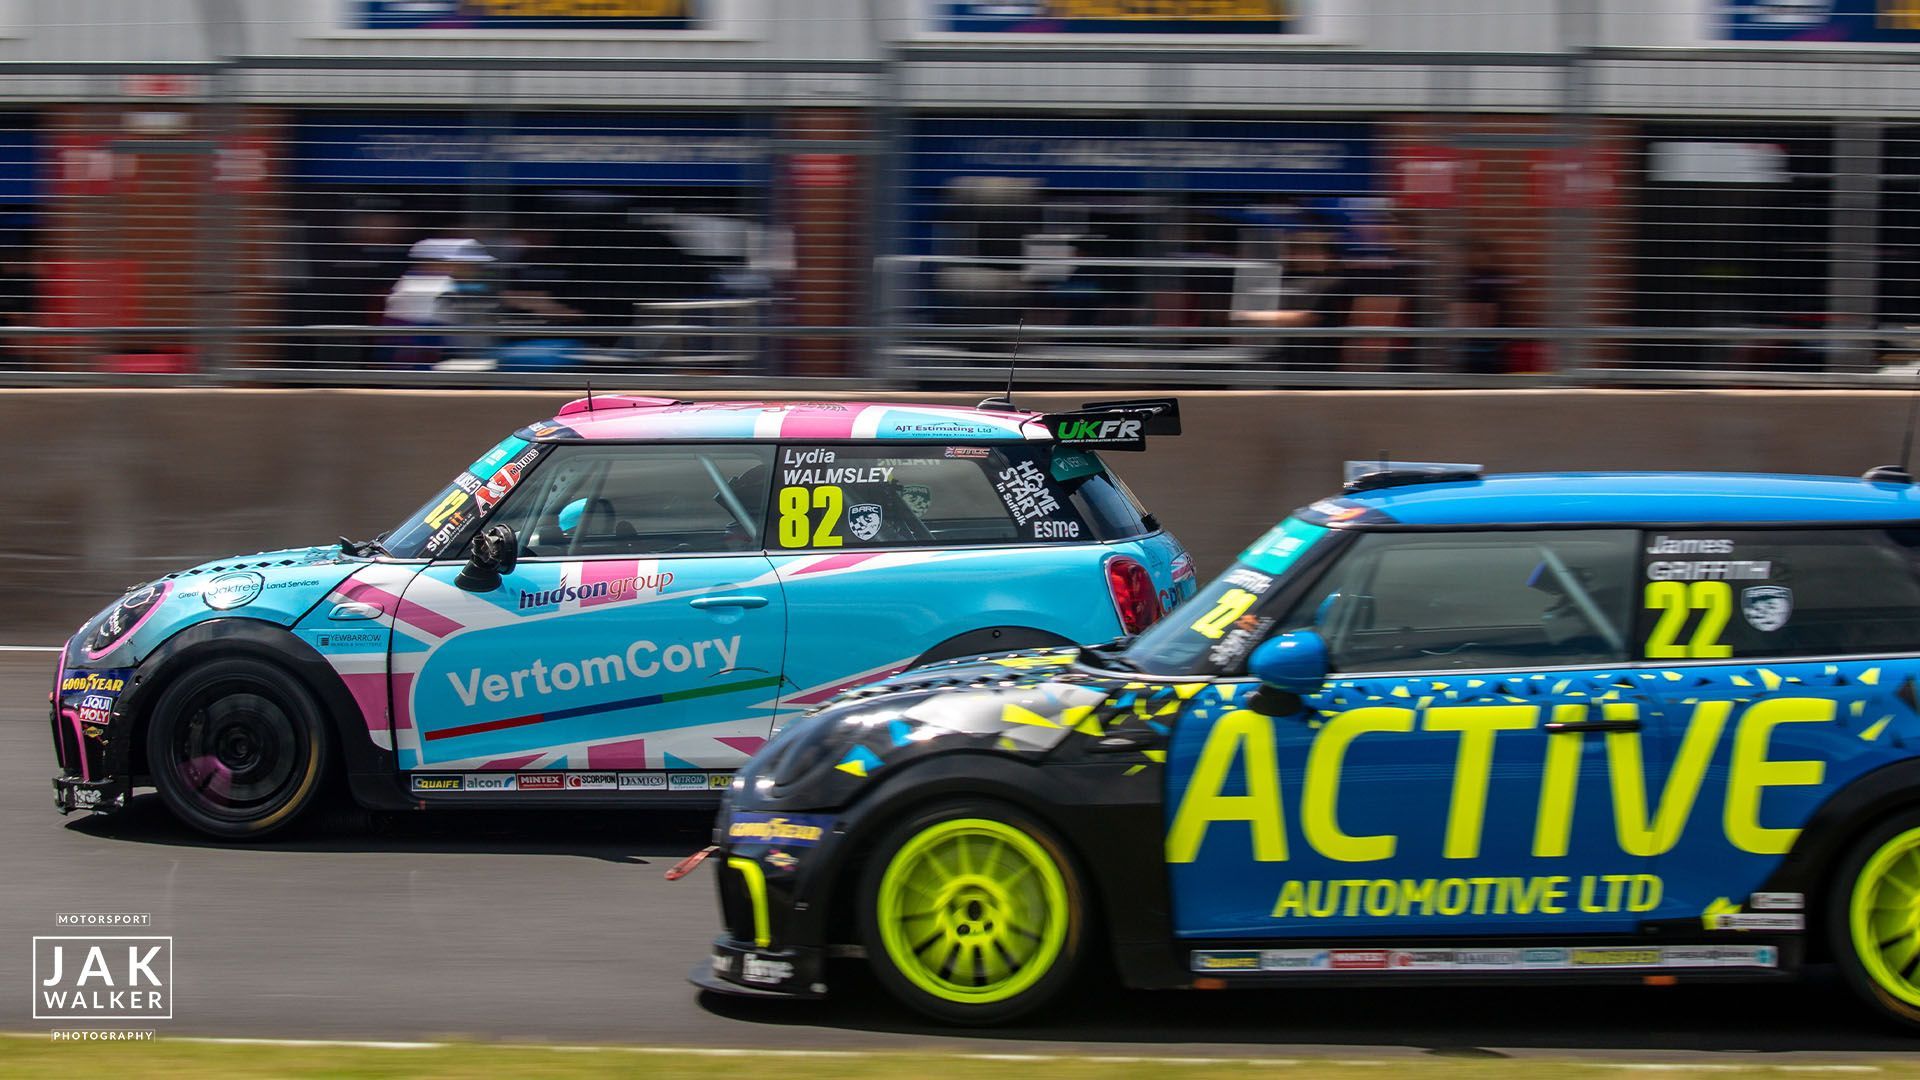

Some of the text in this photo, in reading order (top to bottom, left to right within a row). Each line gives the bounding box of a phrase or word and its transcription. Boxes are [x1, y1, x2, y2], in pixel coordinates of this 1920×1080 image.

[916, 425, 974, 433] Estimating
[1058, 420, 1142, 439] UKFR
[510, 449, 539, 475] MOTORS
[784, 449, 835, 467] Lydia
[783, 467, 894, 485] WALMSLEY
[998, 467, 1043, 519] START
[1016, 460, 1060, 515] HOME
[852, 506, 879, 514] BARC
[996, 482, 1026, 526] in Suffolk
[779, 486, 843, 547] 82
[1034, 521, 1079, 538] Esme
[1647, 536, 1735, 554] James
[1647, 561, 1771, 580] GRIFFITH
[288, 579, 320, 588] Services
[1645, 581, 1733, 658] 22
[330, 634, 381, 642] YEWBARROW
[446, 635, 742, 707] VertomCory
[82, 697, 110, 710] LIQUI
[80, 708, 109, 722] MOLY
[421, 780, 459, 788] QUAIFE
[467, 778, 502, 788] alcon
[521, 776, 560, 784] MINTEX
[582, 776, 616, 785] SCORPION
[673, 776, 703, 785] NITRON
[1165, 698, 1837, 863] ACTIVE
[1272, 874, 1663, 917] AUTOMOTIVE LTD
